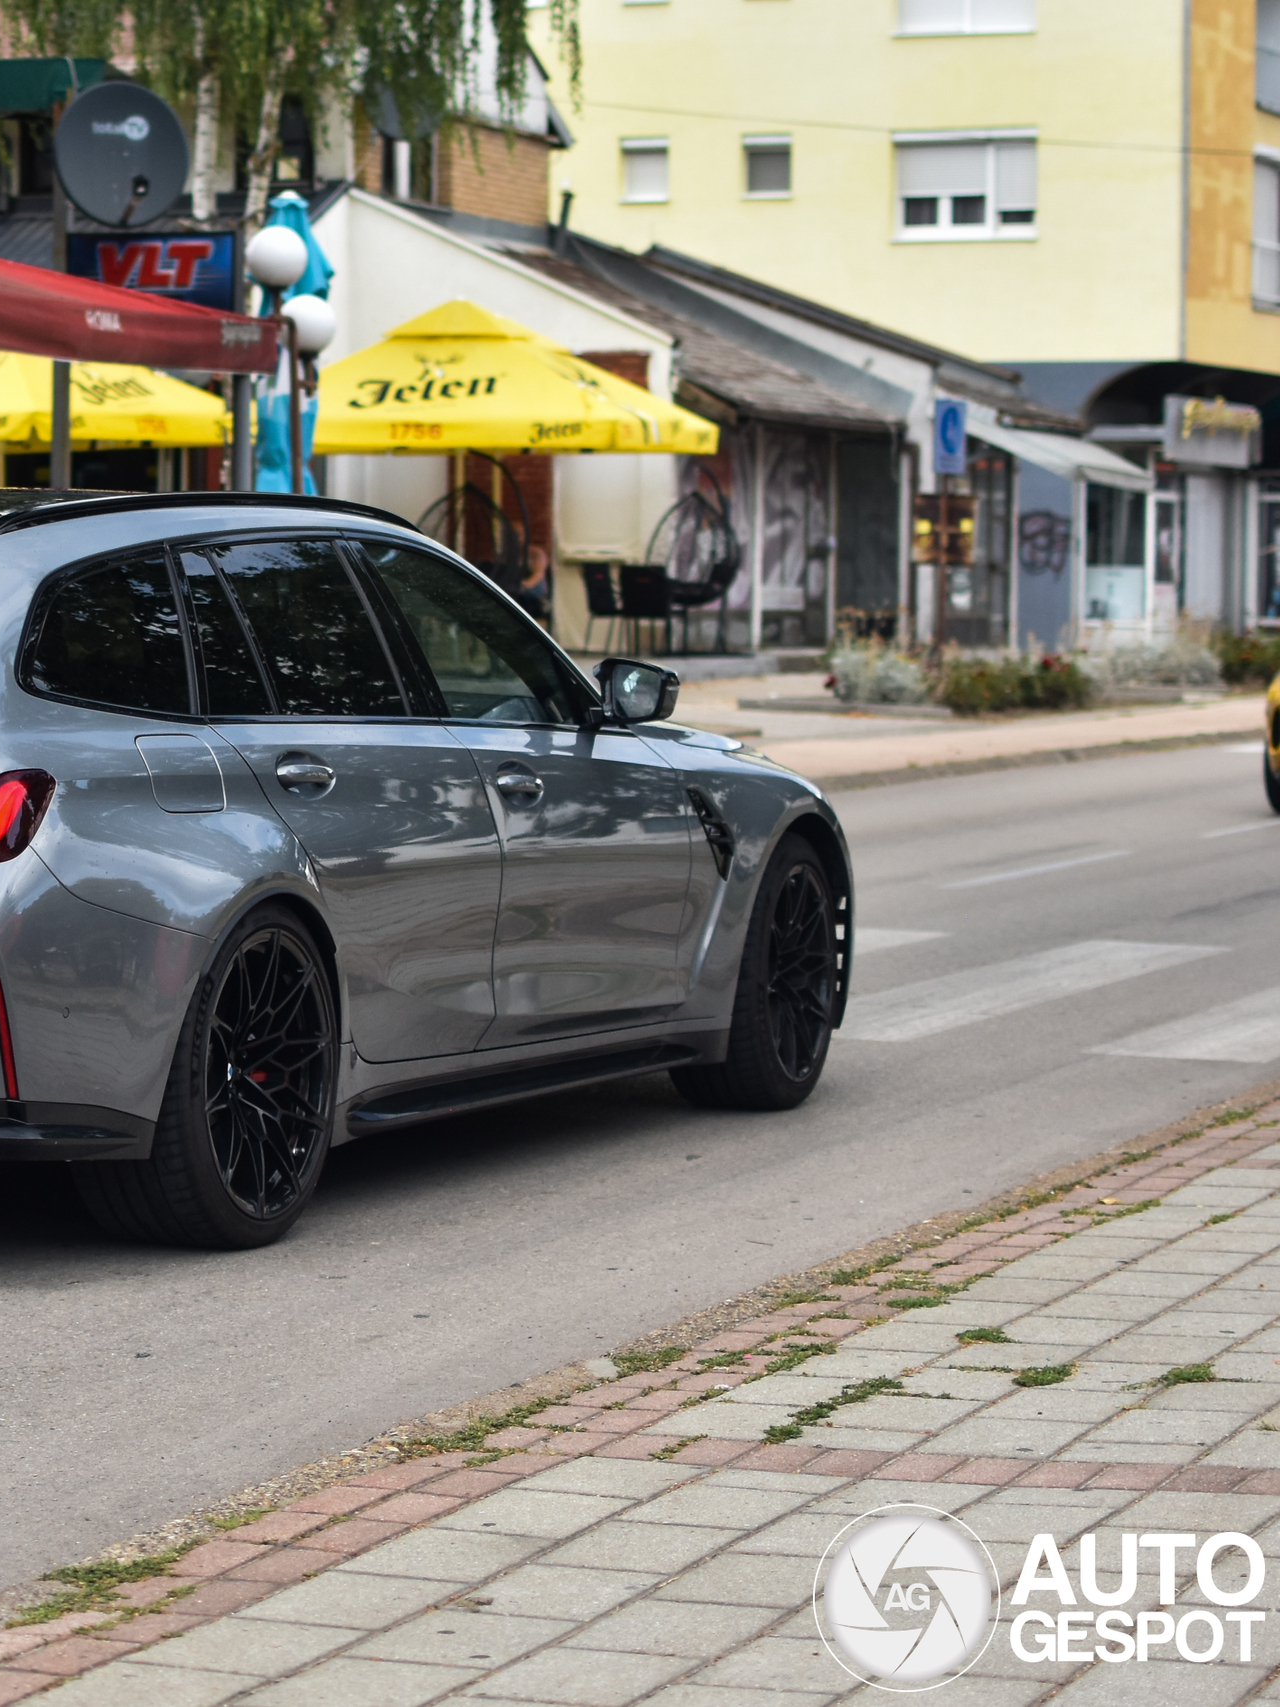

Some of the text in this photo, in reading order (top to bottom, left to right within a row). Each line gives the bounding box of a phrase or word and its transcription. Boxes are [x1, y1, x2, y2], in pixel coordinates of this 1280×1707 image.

[97, 239, 213, 290] VLT
[348, 373, 500, 409] Jelen
[529, 421, 584, 443] Jelen
